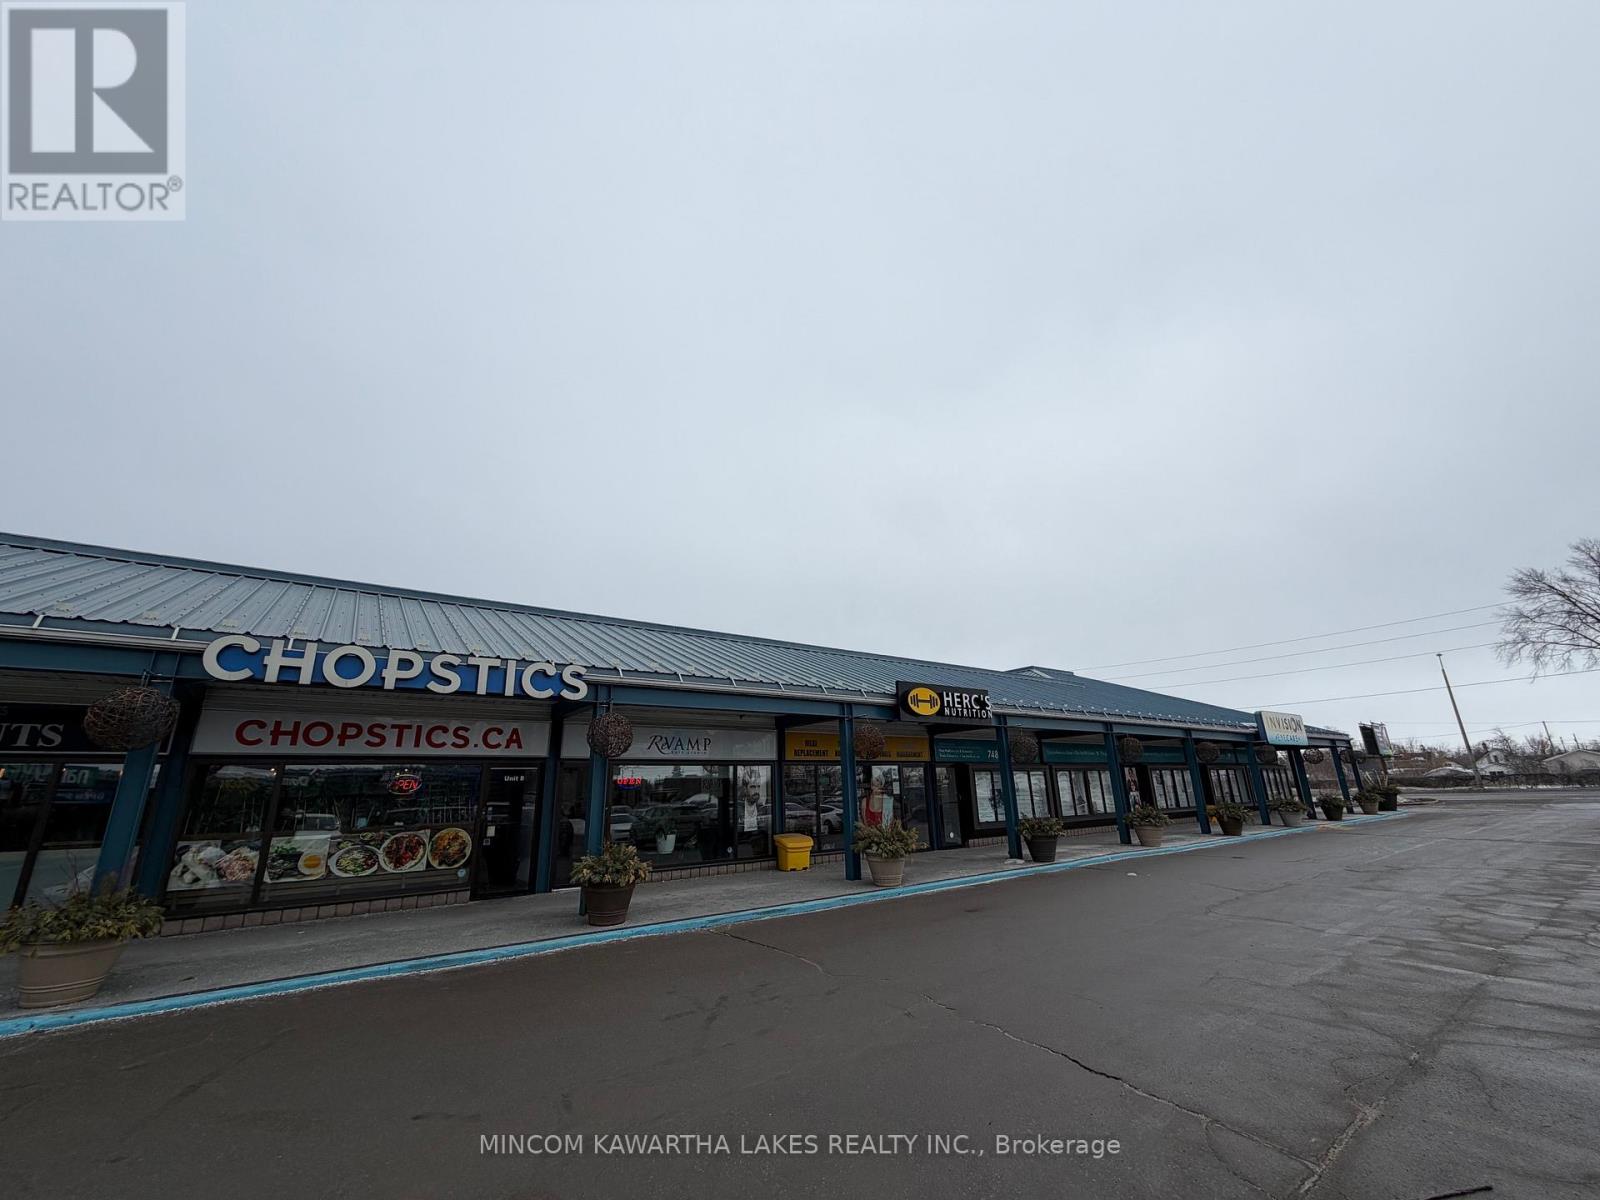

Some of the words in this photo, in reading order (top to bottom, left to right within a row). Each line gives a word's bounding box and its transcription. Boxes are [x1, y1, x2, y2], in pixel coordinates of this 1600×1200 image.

[202, 634, 589, 700] CHOPSTICS
[943, 691, 992, 711] HERC'S
[944, 707, 993, 720] NUTRITION
[1264, 716, 1303, 733] INVISION
[235, 719, 523, 750] CHOPSTICS.CA
[987, 749, 999, 760] 748
[503, 774, 518, 782] Unit
